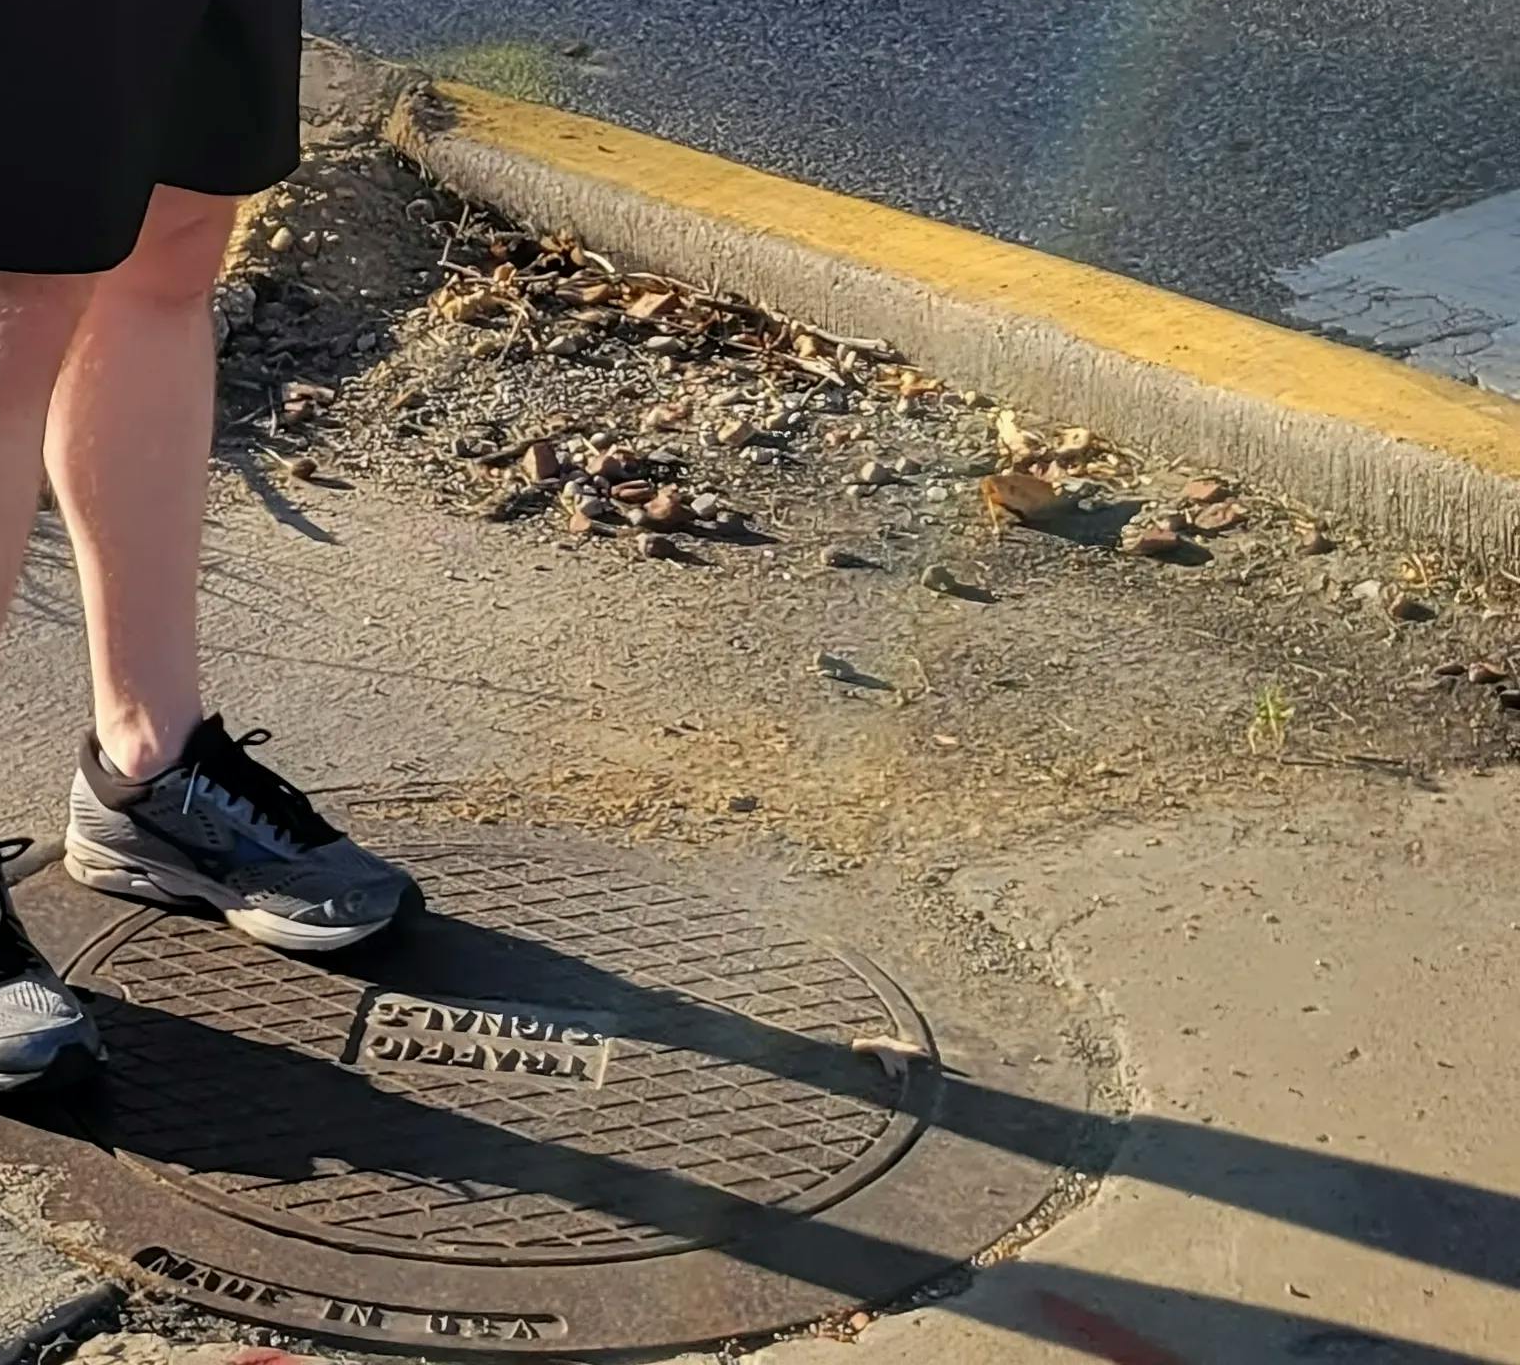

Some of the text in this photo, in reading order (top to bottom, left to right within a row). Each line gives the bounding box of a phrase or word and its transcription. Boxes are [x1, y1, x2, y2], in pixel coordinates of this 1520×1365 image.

[367, 1036, 586, 1083] TRAFFIC
[143, 1252, 292, 1309] MADE
[321, 1298, 382, 1329] IN
